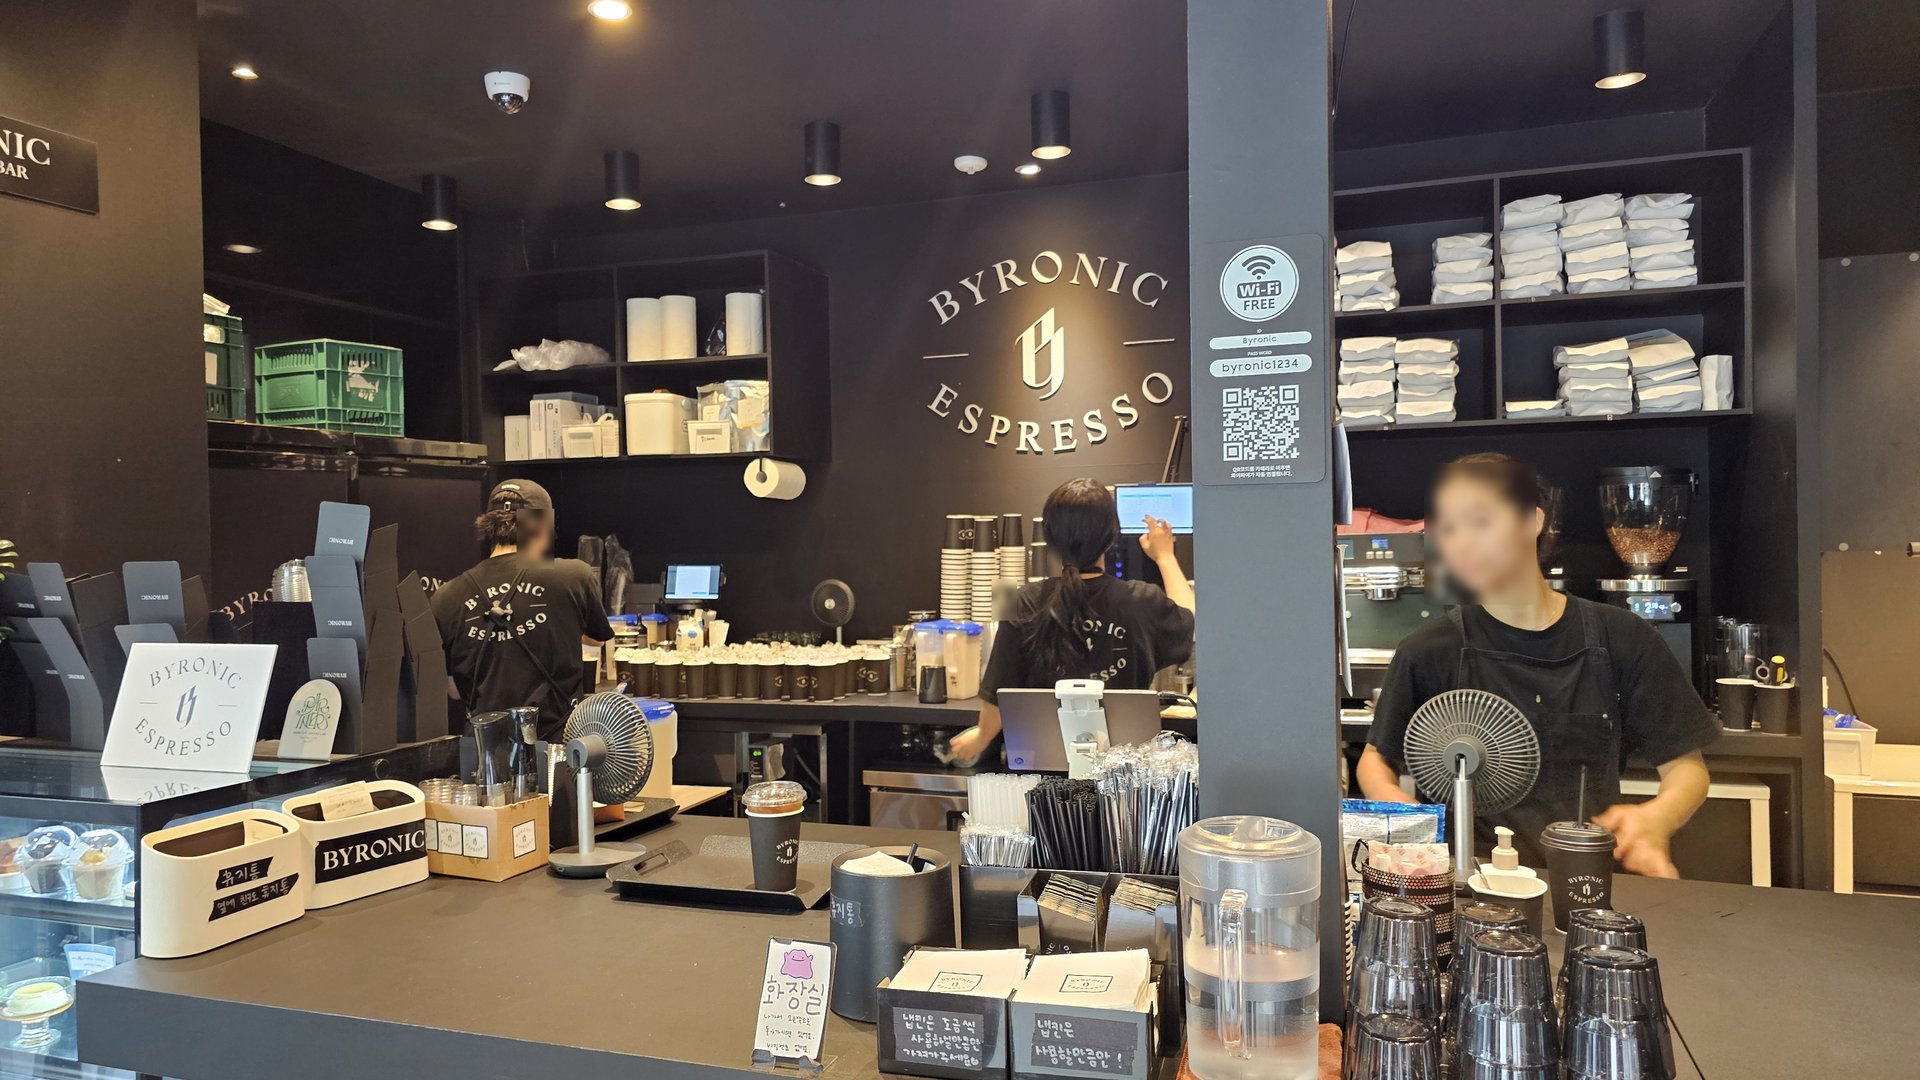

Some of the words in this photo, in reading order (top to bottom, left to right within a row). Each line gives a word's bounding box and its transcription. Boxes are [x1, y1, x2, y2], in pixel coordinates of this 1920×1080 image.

[928, 250, 1168, 326] BYRONIC
[1239, 281, 1280, 298] Wi-Fi
[1243, 298, 1276, 311] FREE
[1242, 335, 1277, 345] Byronic
[1222, 359, 1299, 374] byronic1234
[927, 372, 1173, 454] ESPRESSO
[464, 582, 545, 611] BRONIC
[149, 656, 243, 689] BYRONIC
[135, 718, 232, 756] ESPRESSO
[322, 829, 425, 871] BYRONIC
[222, 862, 261, 887] 휴지통
[1567, 875, 1604, 885] BYRONIC
[1568, 891, 1605, 904] ESPRESSO
[763, 974, 825, 1016] 화장실
[902, 1013, 935, 1031] 냅킨은
[941, 1017, 976, 1034] 조금씩
[1037, 1019, 1075, 1039] 냅킨은
